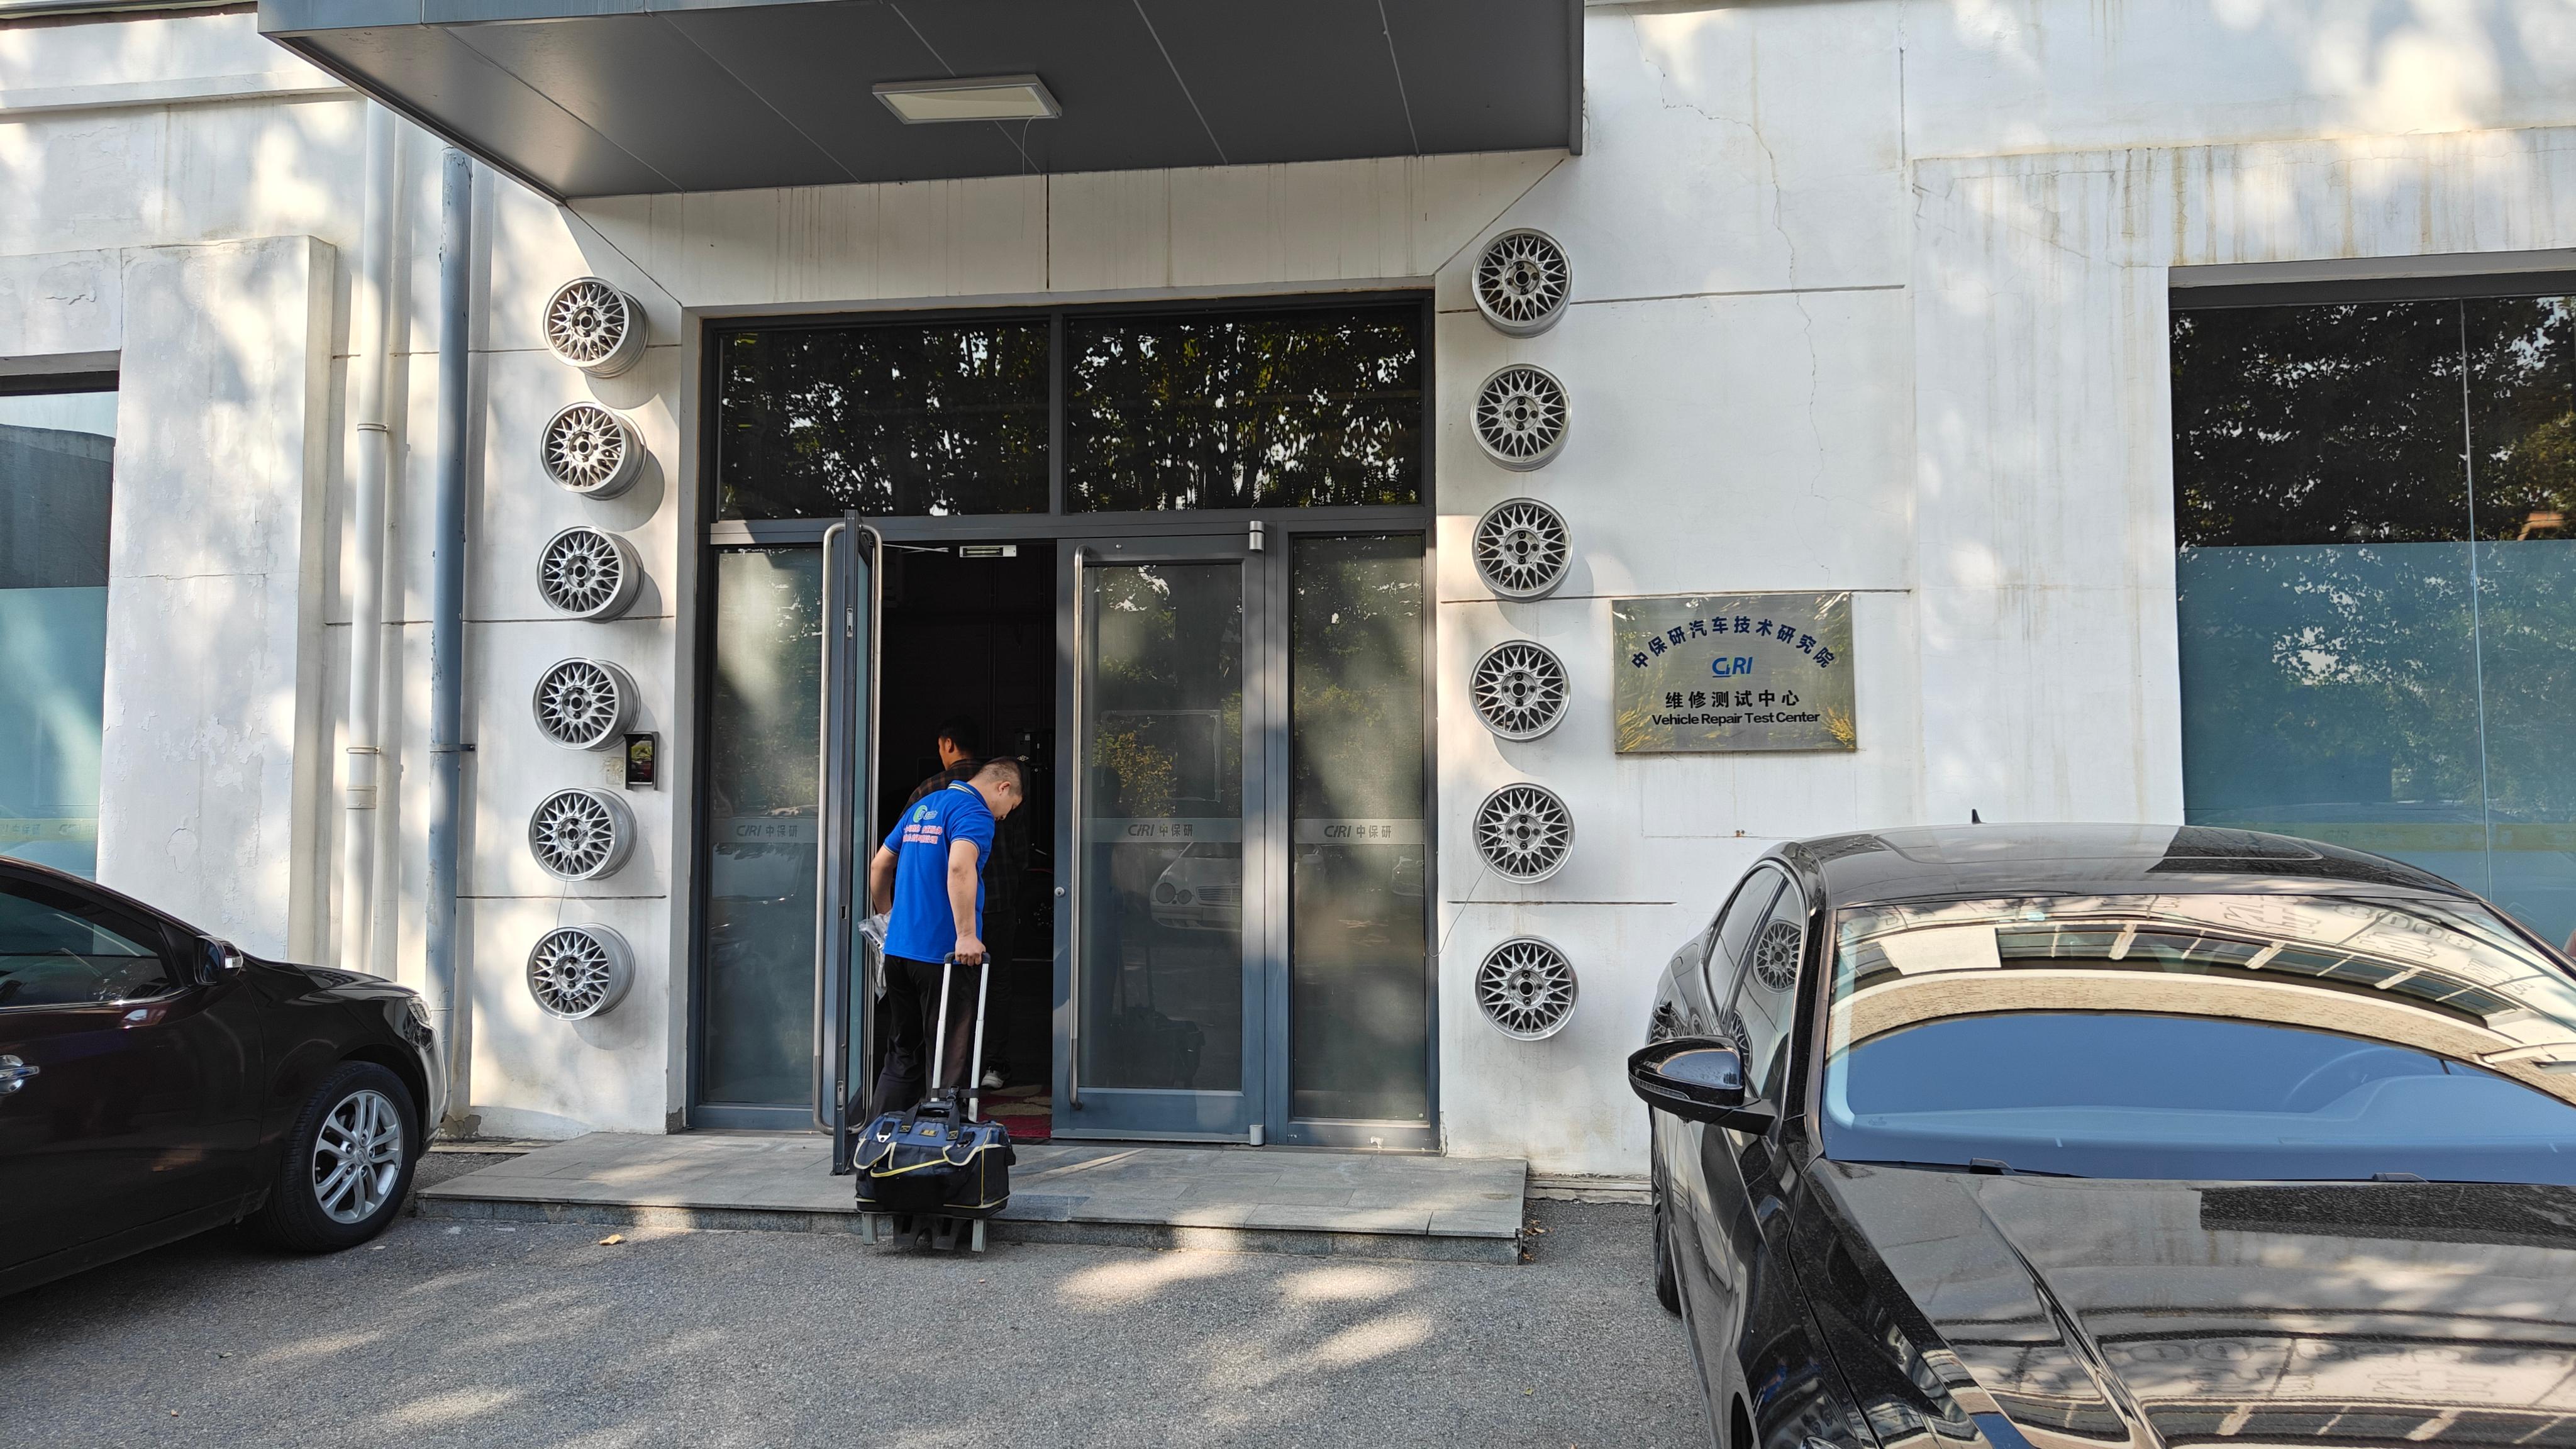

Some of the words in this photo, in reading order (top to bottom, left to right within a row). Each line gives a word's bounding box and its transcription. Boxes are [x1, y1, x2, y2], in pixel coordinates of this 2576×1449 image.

[1631, 616, 1835, 669] 中保研汽车技术研究院
[1665, 689, 1800, 709] 维修测试中心
[1652, 713, 1699, 725] Vehicle
[1701, 713, 1743, 726] Repair
[1745, 712, 1774, 723] Test
[1776, 711, 1821, 723] Center
[736, 824, 762, 837] CIRI
[765, 824, 798, 838] 中保研
[1128, 824, 1155, 836] CIRI
[1159, 823, 1193, 837] 中保研
[1324, 825, 1352, 838] CIRI
[1356, 824, 1392, 838] 中保研
